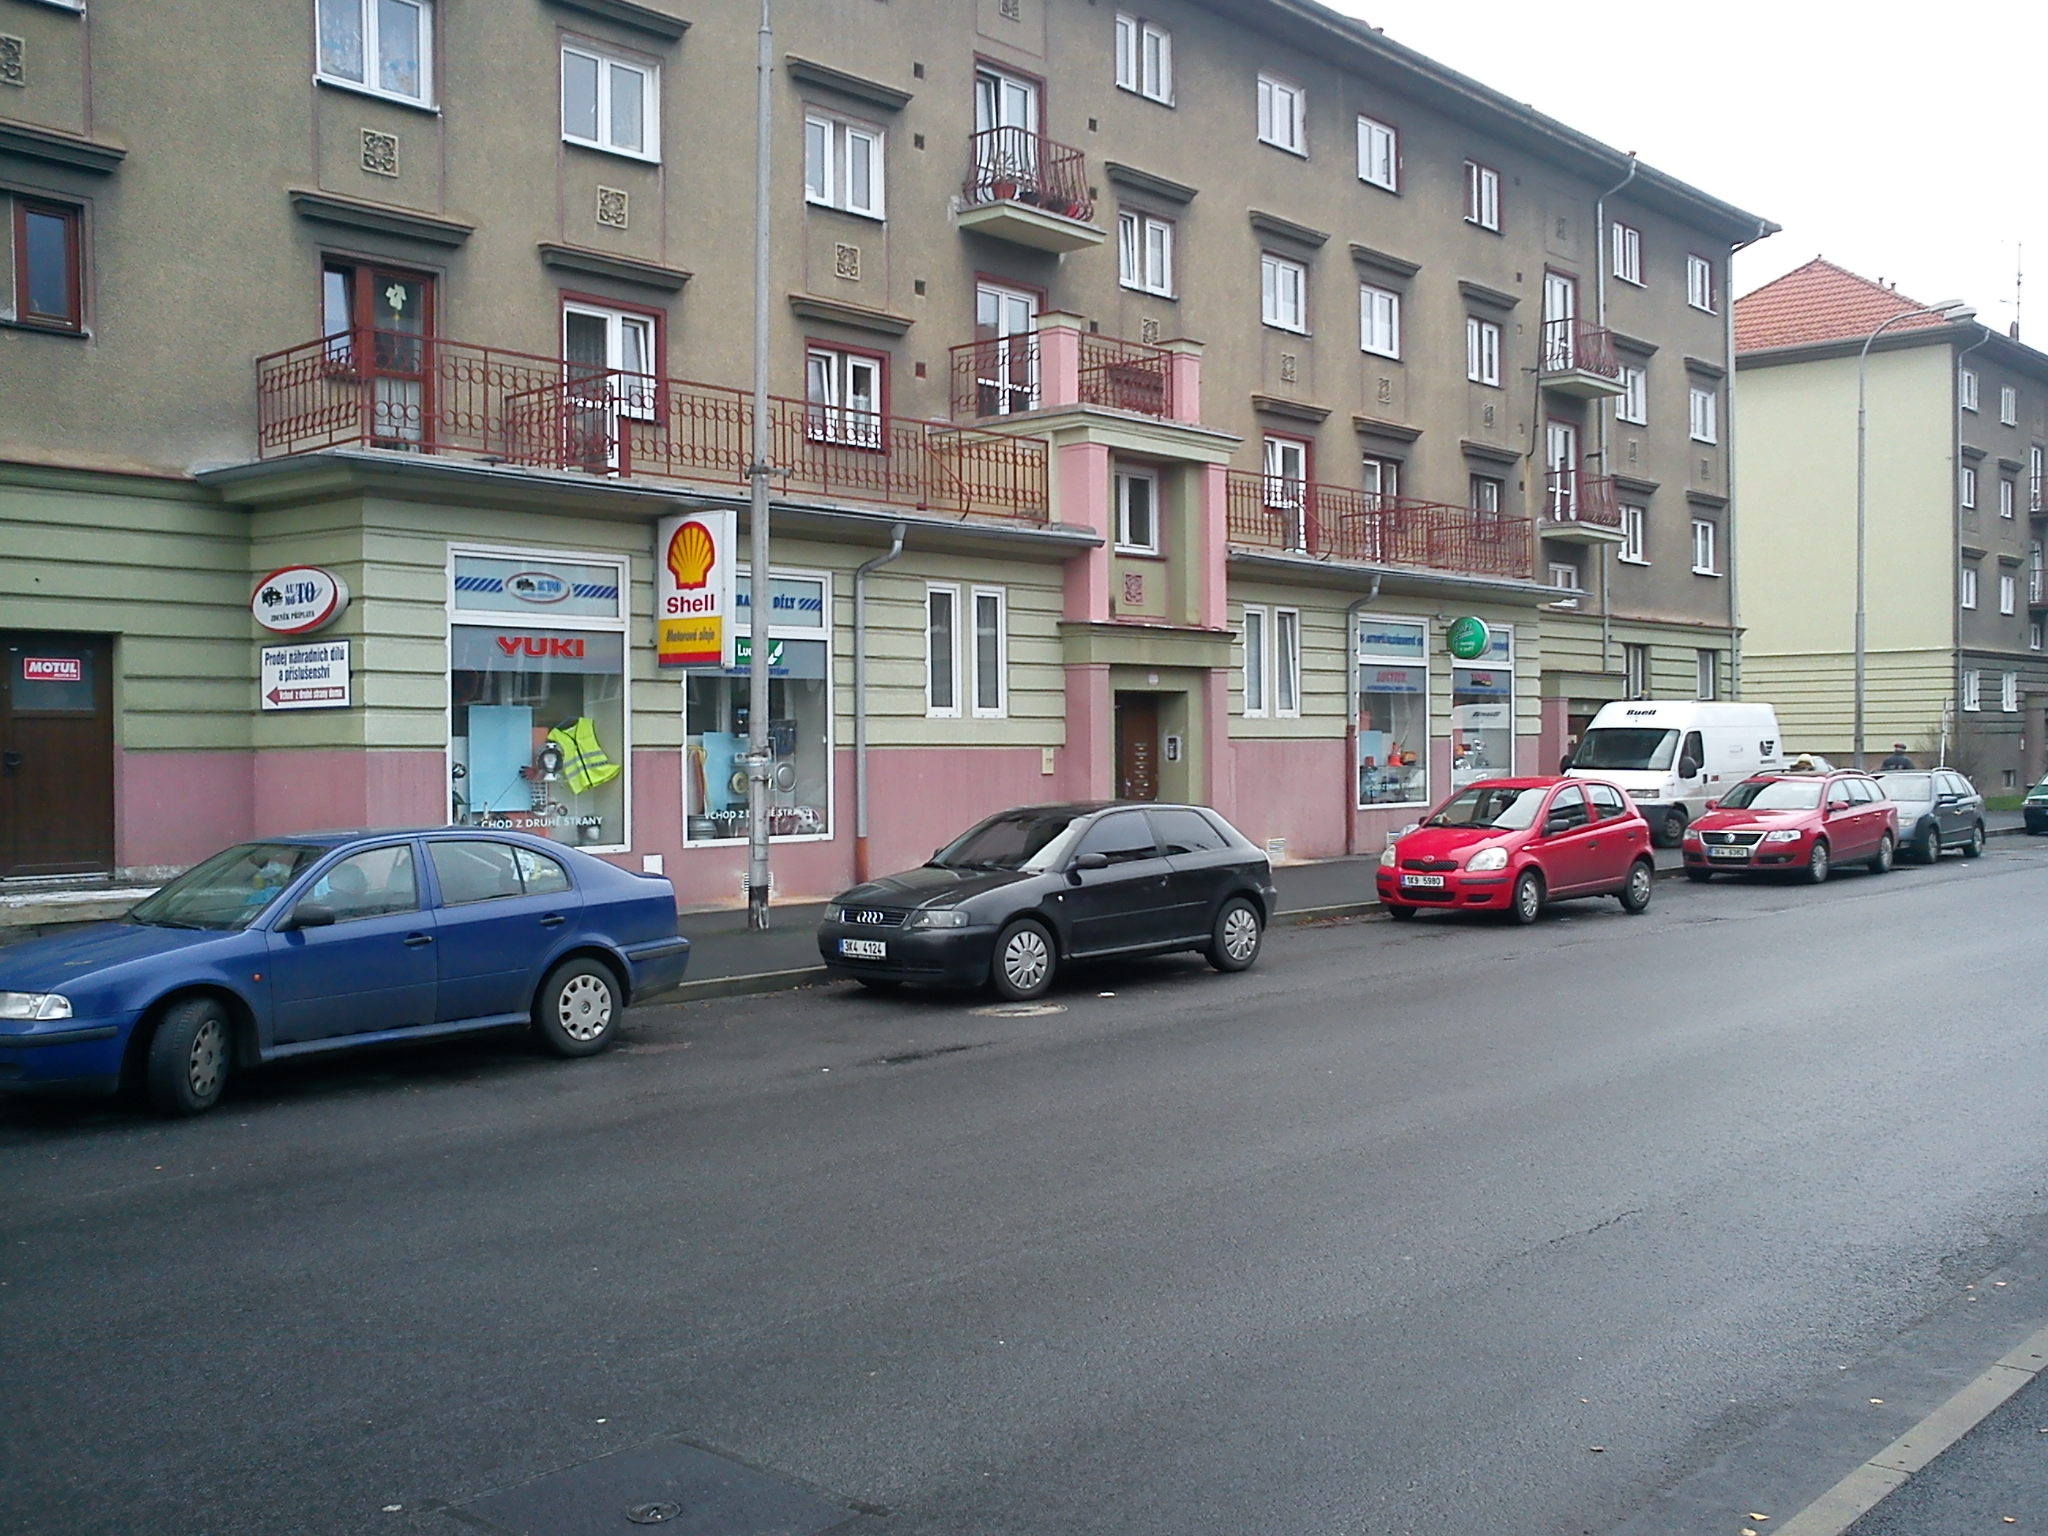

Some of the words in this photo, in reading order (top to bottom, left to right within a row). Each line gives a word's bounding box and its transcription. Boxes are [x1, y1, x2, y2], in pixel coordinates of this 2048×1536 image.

[667, 594, 715, 614] Shell
[773, 593, 796, 609] DÍLY
[497, 636, 586, 659] YUKI
[265, 651, 288, 666] Prodej
[289, 648, 329, 664] náhradních
[331, 646, 345, 661] dílů
[29, 661, 77, 673] MOTUL
[279, 670, 283, 682] a
[481, 820, 513, 829] CHOD
[516, 819, 523, 828] Z
[526, 816, 561, 828] DRUHÉ
[564, 816, 603, 827] STRANY
[738, 811, 744, 819] Z
[844, 940, 858, 953] 3K4
[862, 942, 882, 955] 4124
